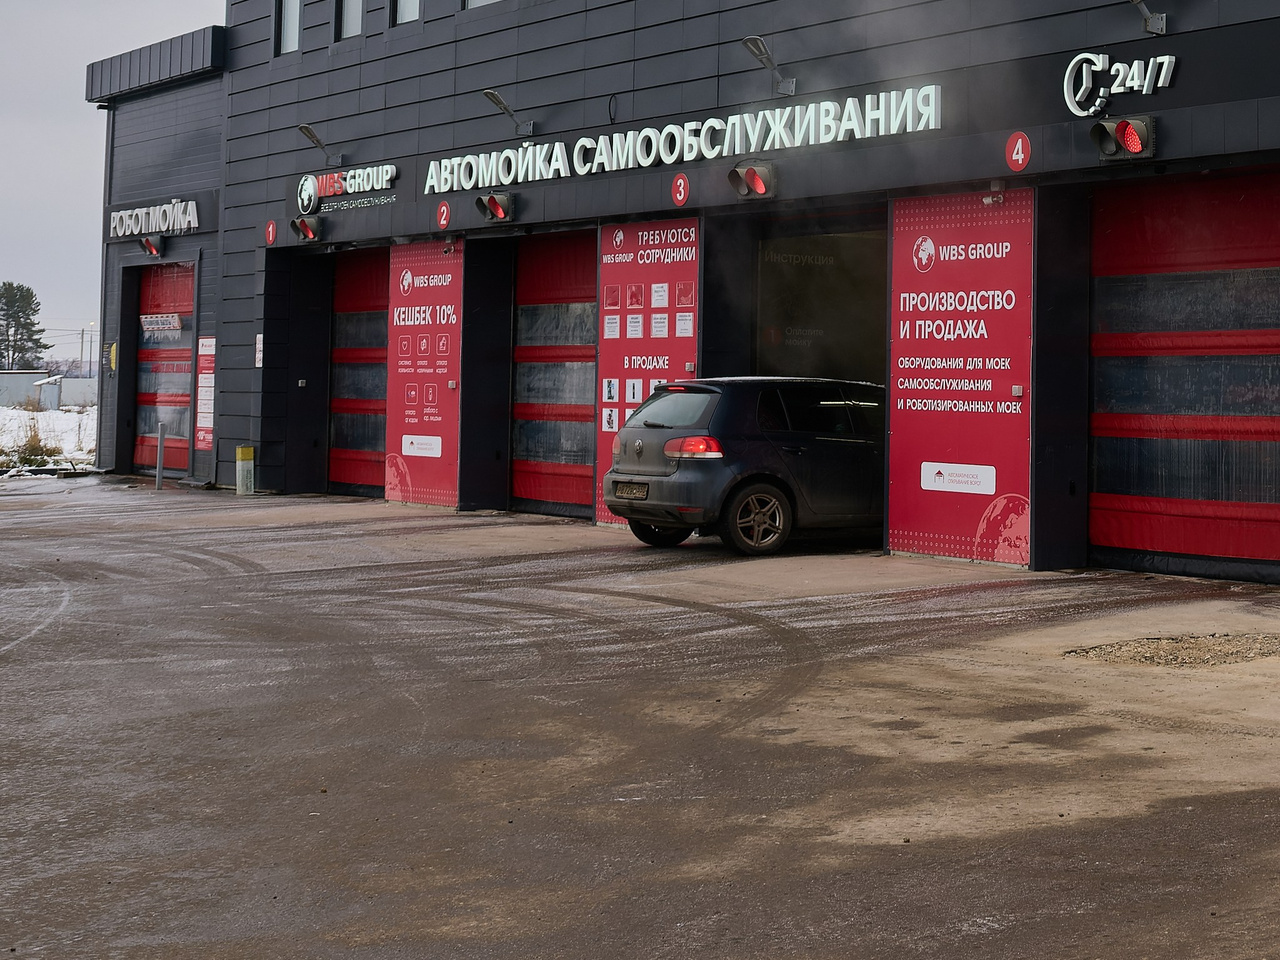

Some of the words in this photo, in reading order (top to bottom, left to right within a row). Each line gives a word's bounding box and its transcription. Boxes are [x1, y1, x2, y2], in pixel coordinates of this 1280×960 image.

[1110, 55, 1176, 95] 24/7
[424, 142, 571, 195] АВТОМОЙКА
[573, 84, 942, 175] САМООБСЛУЖИВАНИЯ
[1012, 138, 1025, 164] 4
[317, 171, 346, 198] WBS
[346, 165, 397, 193] GROUP
[676, 178, 685, 200] 3
[440, 205, 448, 225] 2
[268, 224, 273, 241] 1
[638, 227, 696, 246] ТРЕБУЮТСЯ
[602, 253, 615, 264] WBS
[615, 252, 635, 263] GROUP
[637, 247, 696, 264] СОТРУДНИКИ
[764, 250, 835, 266] Инструкция
[939, 244, 966, 261] WBS
[968, 242, 1011, 260] GROUP
[413, 275, 428, 288] WBS
[429, 273, 452, 287] GROUP
[900, 289, 1016, 313] ПРОИЗВОДСТВО
[393, 305, 433, 326] КЕШБЕК
[435, 304, 457, 325] 10%
[900, 320, 910, 339] И
[915, 319, 988, 341] ПРОДАЖА
[624, 356, 629, 369] В
[631, 356, 669, 370] ПРОДАЖЕ
[897, 356, 964, 370] ОБОРУДОВАНИЯ
[966, 357, 983, 371] ДЛЯ
[985, 358, 1012, 370] МОЕК
[897, 377, 992, 391] САМООБСЛУЖИВАНИЯ
[897, 398, 904, 410] И
[906, 398, 994, 413] РОБОТИЗИРОВАННЫХ
[996, 401, 1022, 414] МОЕК
